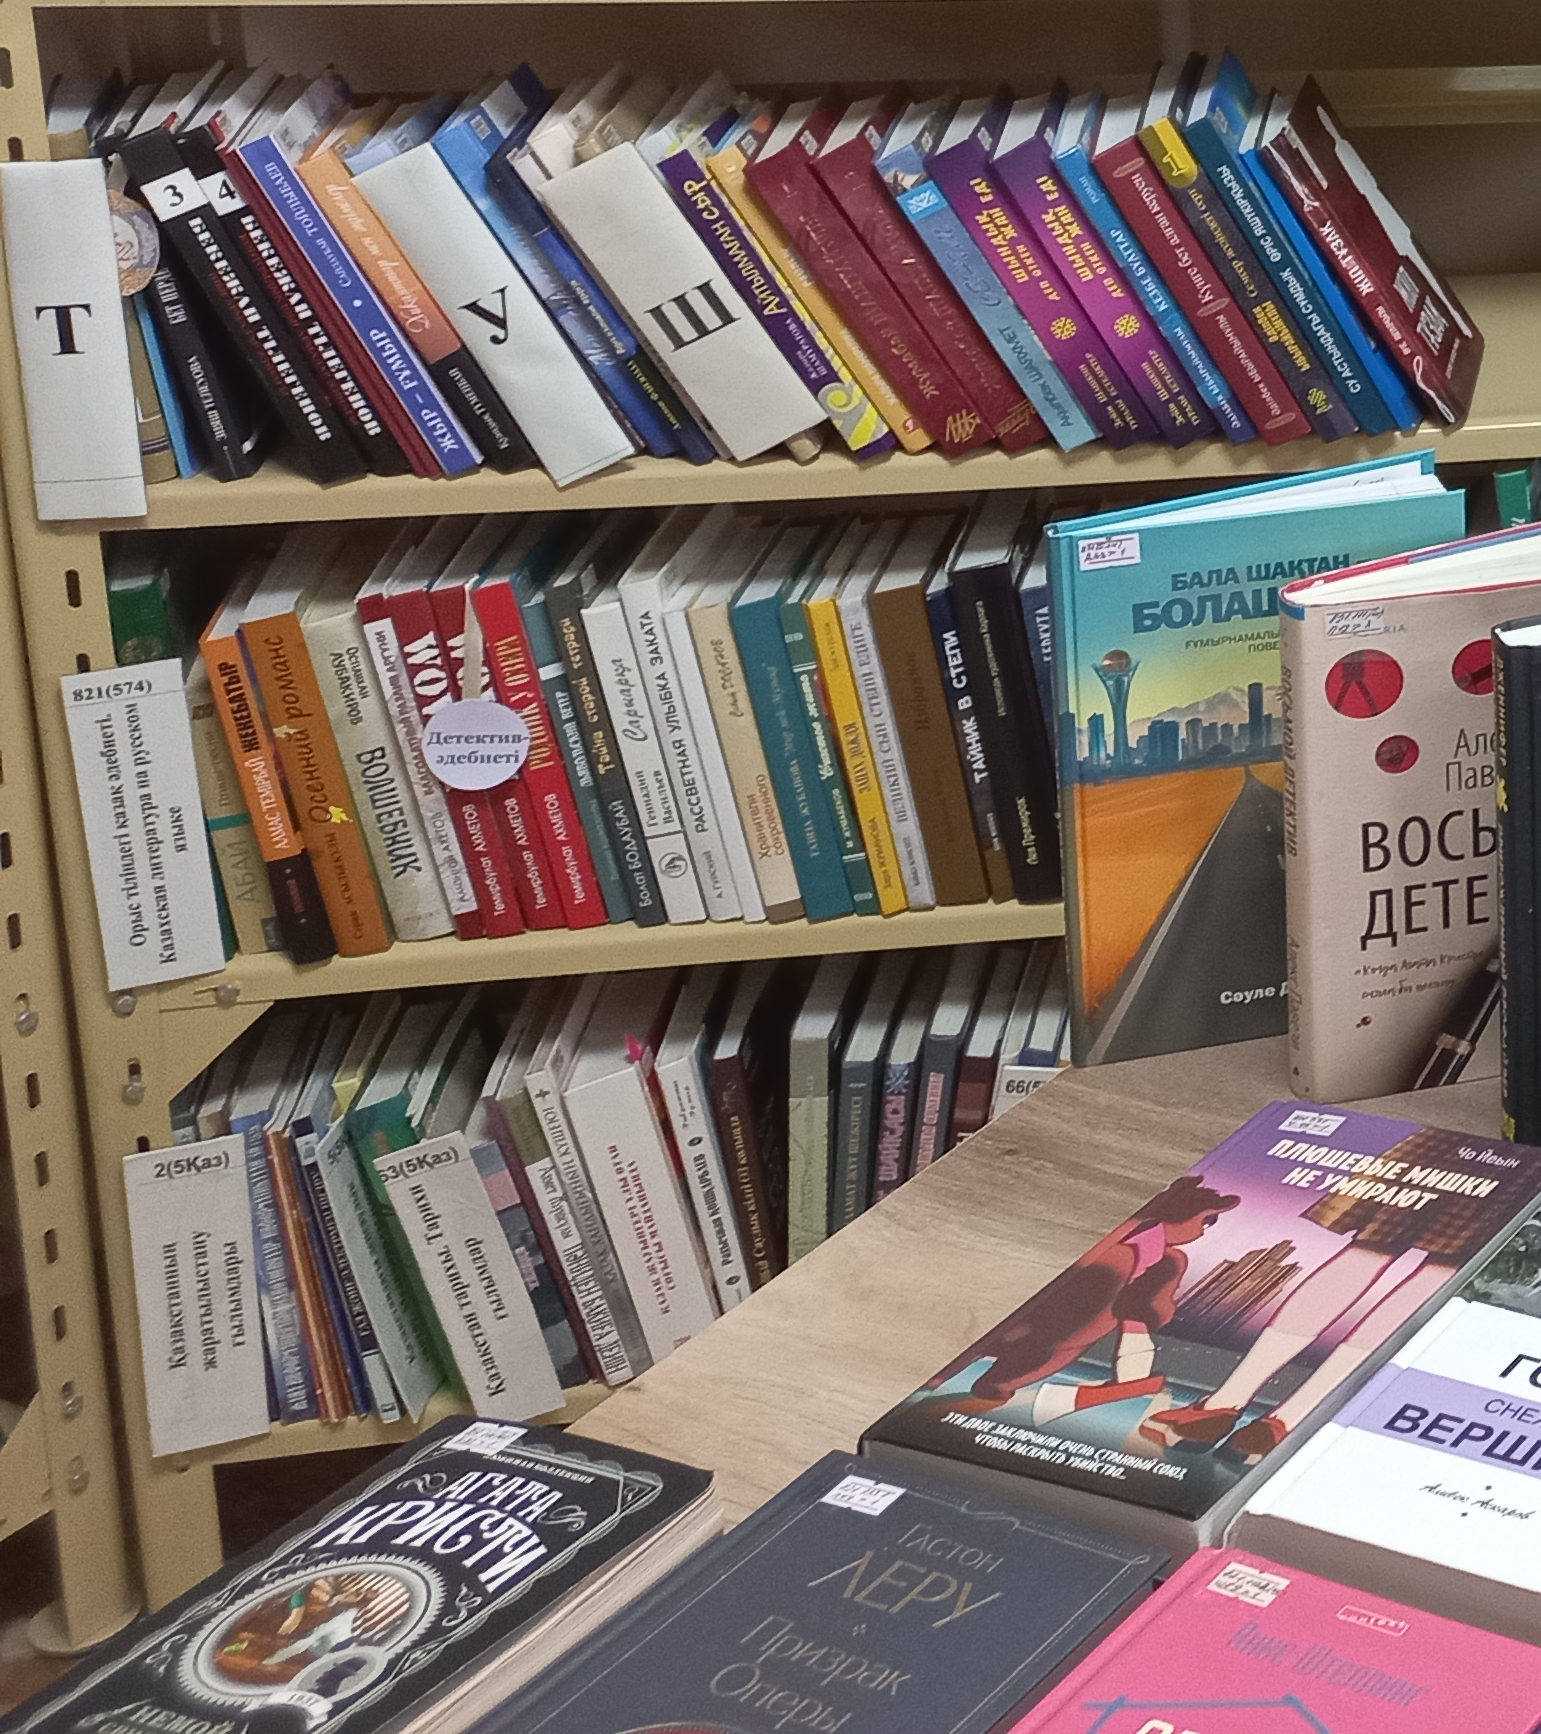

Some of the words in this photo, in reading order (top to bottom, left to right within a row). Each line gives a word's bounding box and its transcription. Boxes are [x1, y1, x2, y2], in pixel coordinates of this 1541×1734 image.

[163, 183, 186, 207] 3
[217, 178, 238, 201] 4
[34, 301, 93, 356] Т
[458, 284, 517, 345] У
[644, 278, 743, 353] Ш
[72, 680, 152, 702] 821(574)
[427, 732, 530, 747] Детектив-
[436, 750, 520, 766] әдебиеті
[170, 806, 188, 852] языке
[356, 746, 422, 878] ВОЛШЕБНИК
[1361, 806, 1498, 874] ВОСЬ
[1360, 874, 1490, 951] ДЕТЕ
[1220, 986, 1276, 1006] Соуле
[1267, 1137, 1408, 1184] ПЛЮШЕВЫЕ
[1403, 1162, 1500, 1201] МИШКИ
[440, 1469, 562, 1524] АГАТА
[319, 1499, 552, 1596] КРИСТИ
[896, 1523, 1005, 1576] ГАСТОН
[807, 1550, 1005, 1630] ЛЕРУ
[708, 1662, 854, 1733] Оперы
